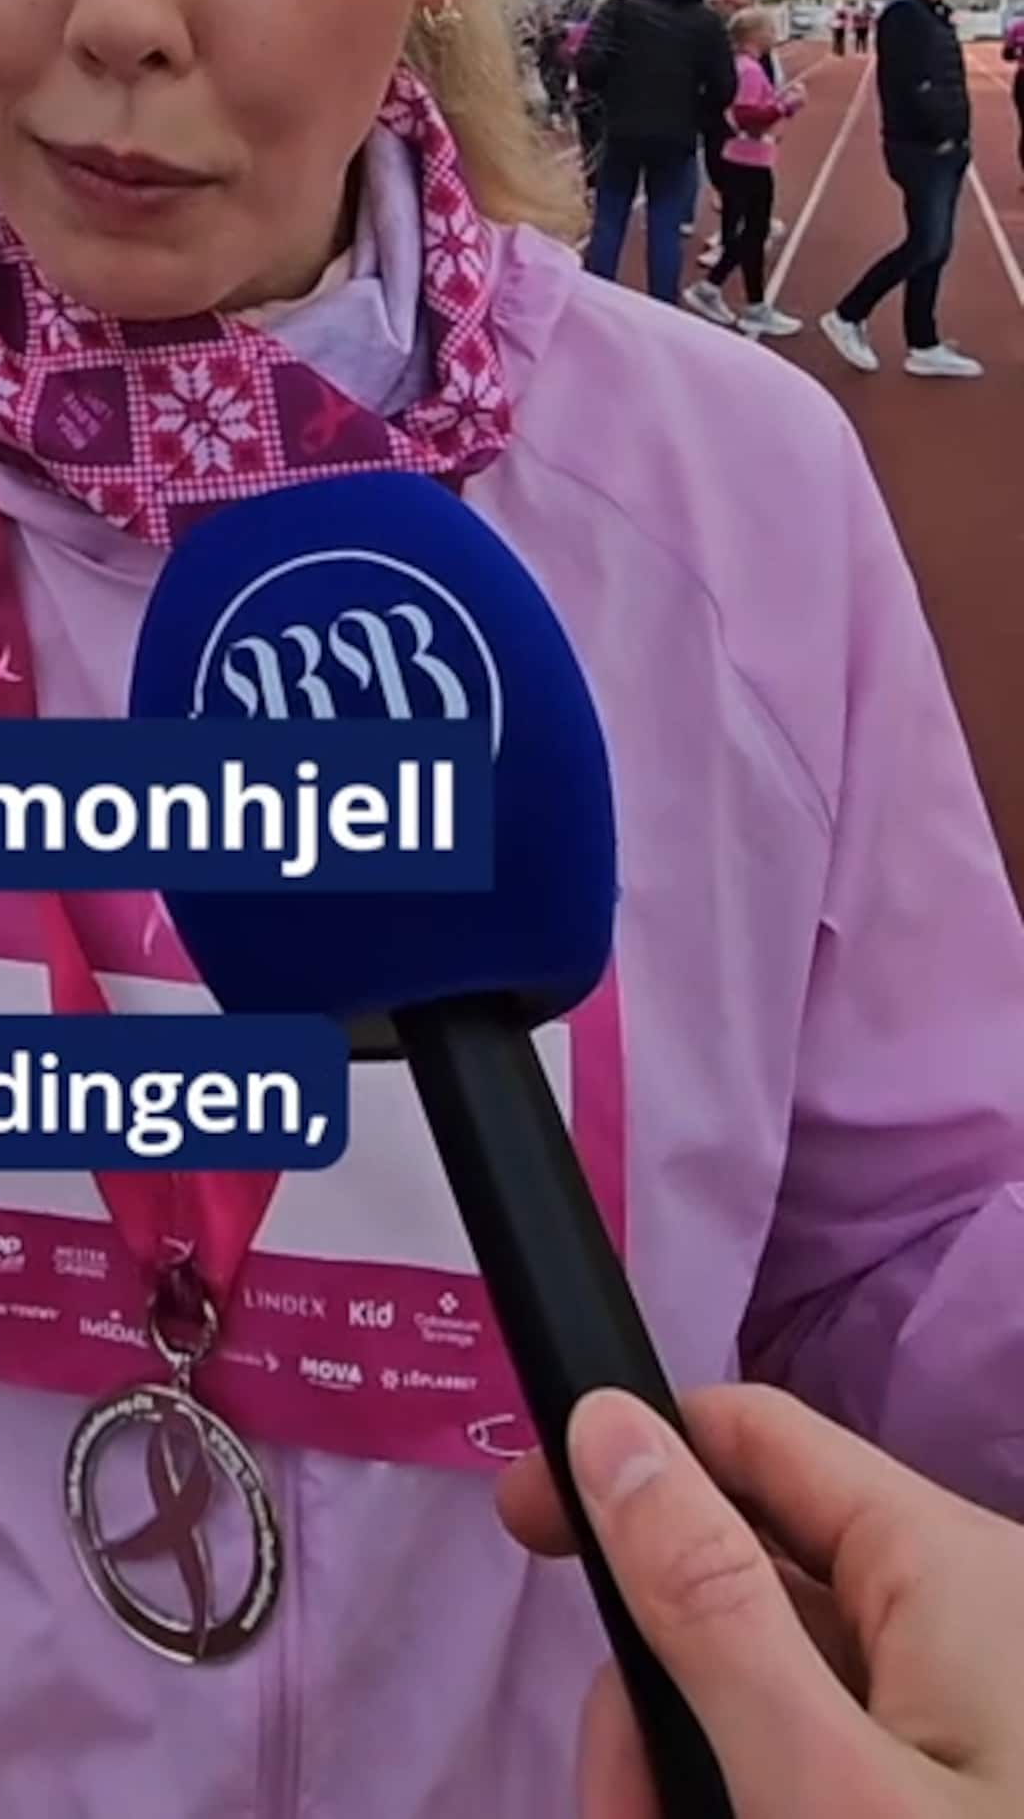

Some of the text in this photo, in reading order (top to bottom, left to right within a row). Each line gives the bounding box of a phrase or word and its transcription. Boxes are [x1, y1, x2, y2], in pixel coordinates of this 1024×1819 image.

[243, 1288, 327, 1317] LINDEX
[349, 1300, 394, 1328] Kid
[300, 1356, 363, 1383] MOVA
